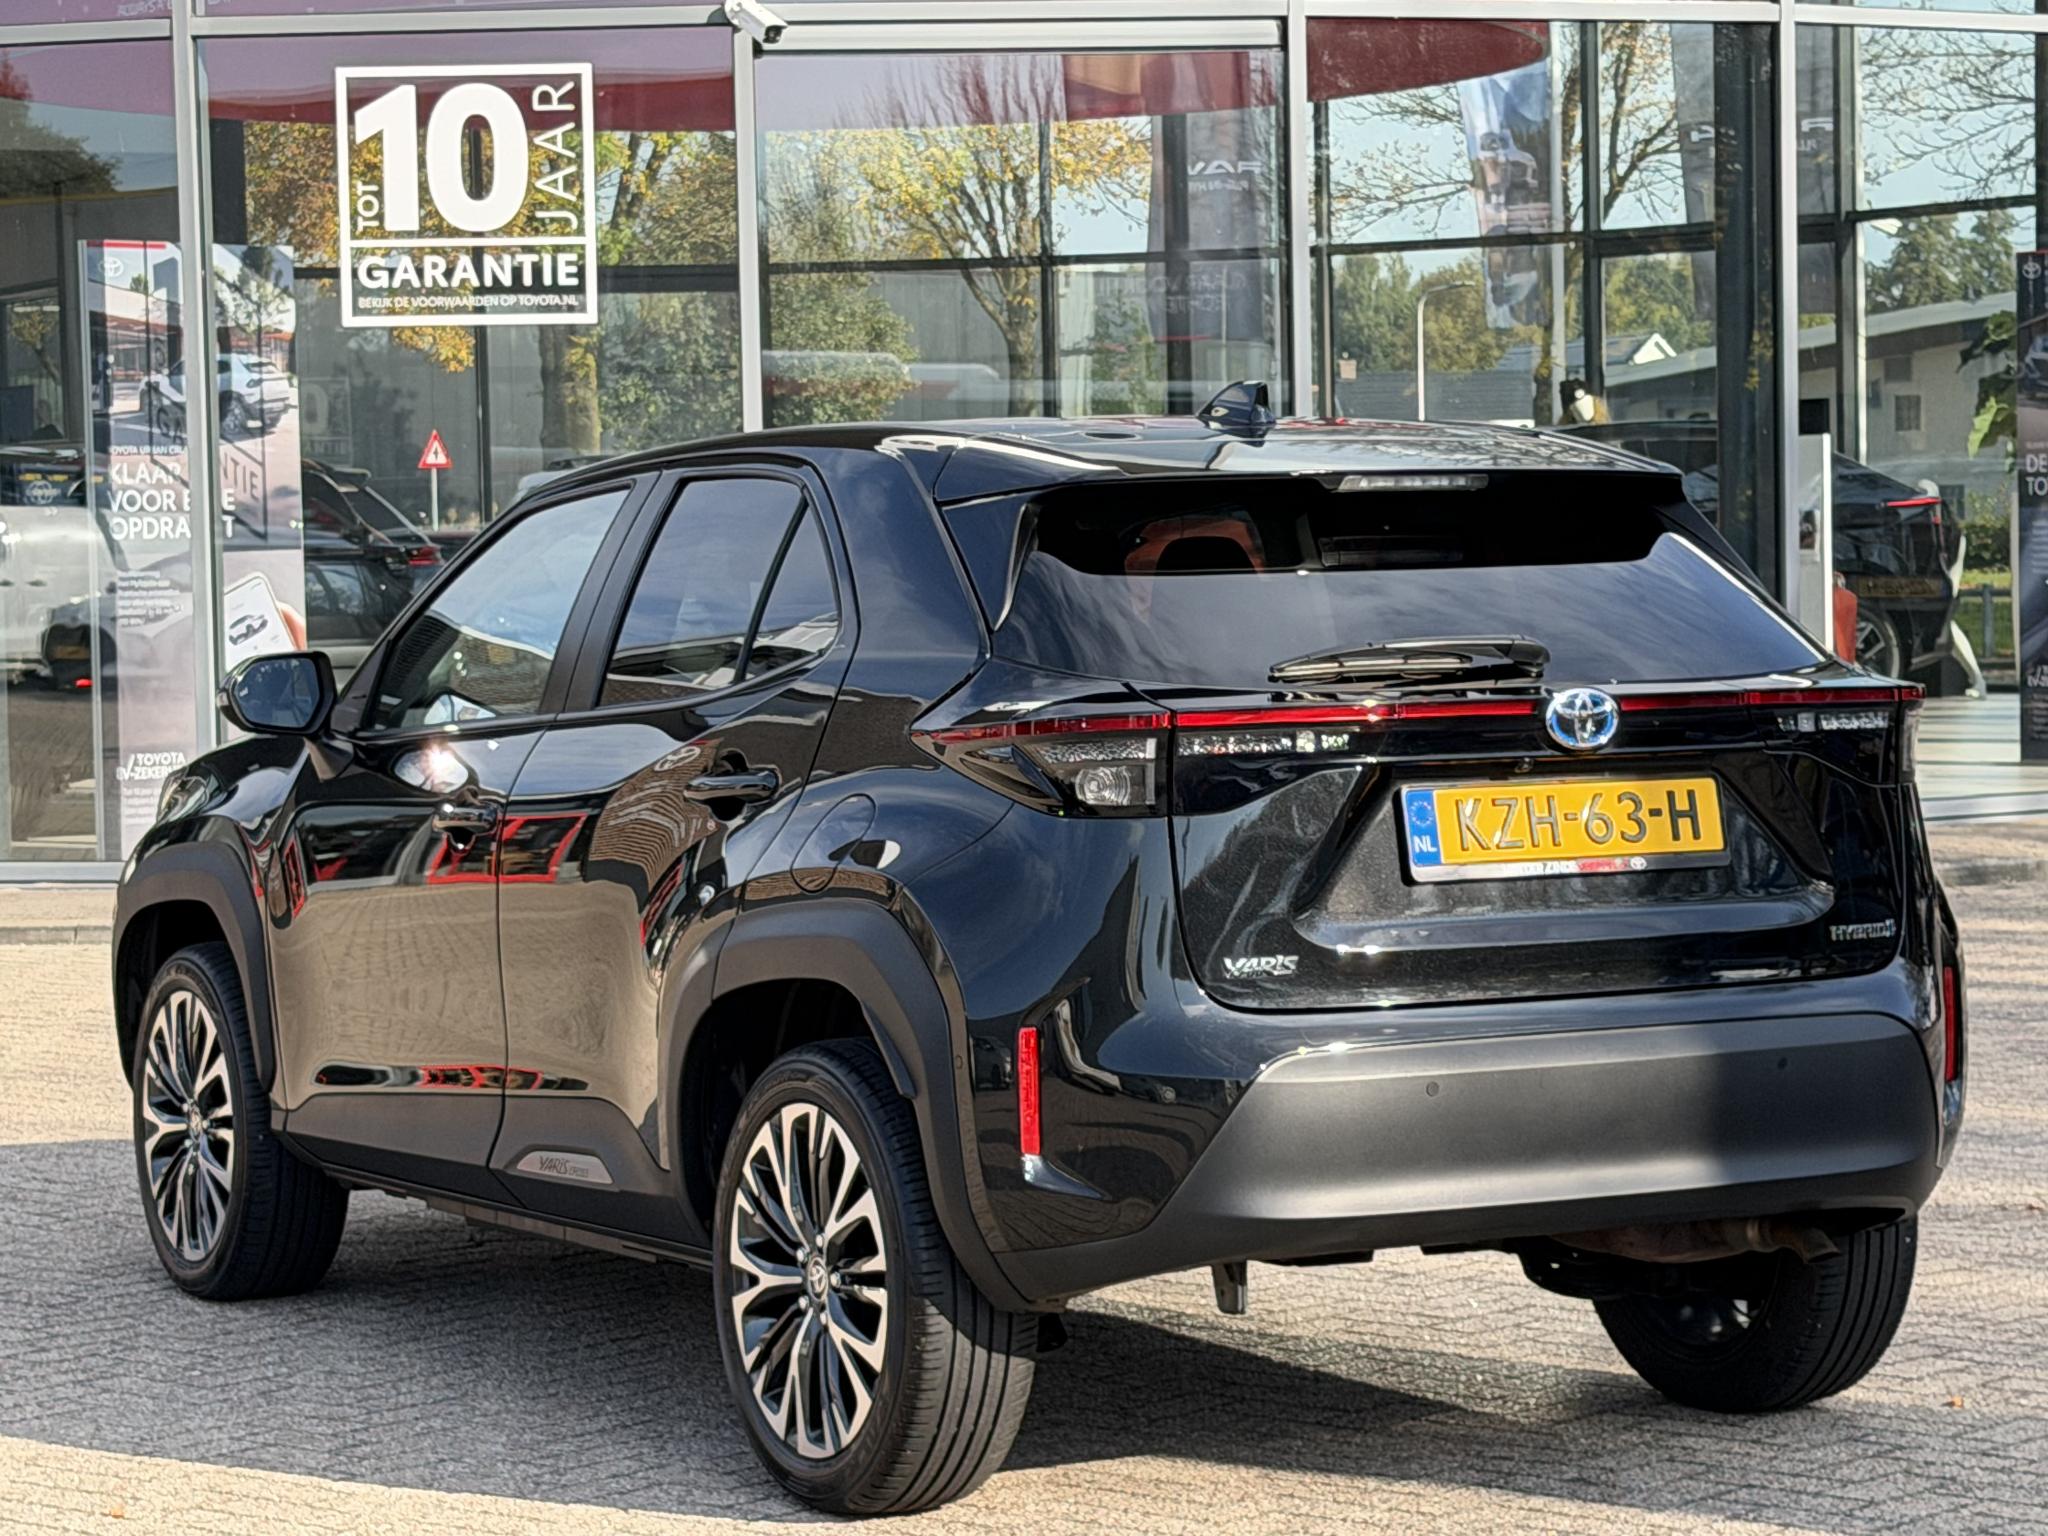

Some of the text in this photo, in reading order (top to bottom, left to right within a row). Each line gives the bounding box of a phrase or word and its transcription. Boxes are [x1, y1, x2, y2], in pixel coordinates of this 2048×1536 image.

[354, 81, 578, 232] TOT 10 JAAR
[357, 253, 579, 289] GARANTIE
[358, 296, 393, 309] BEKIJK
[394, 296, 411, 309] DE
[412, 294, 498, 309] VOORWAARDEN
[500, 294, 517, 307] OP
[107, 489, 177, 512] VOOR
[136, 751, 186, 766] TOYOTA
[1455, 789, 1702, 851] KZH-63-H
[1413, 835, 1438, 853] NL
[1223, 954, 1299, 979] YARIS
[539, 1156, 570, 1175] YARIS
